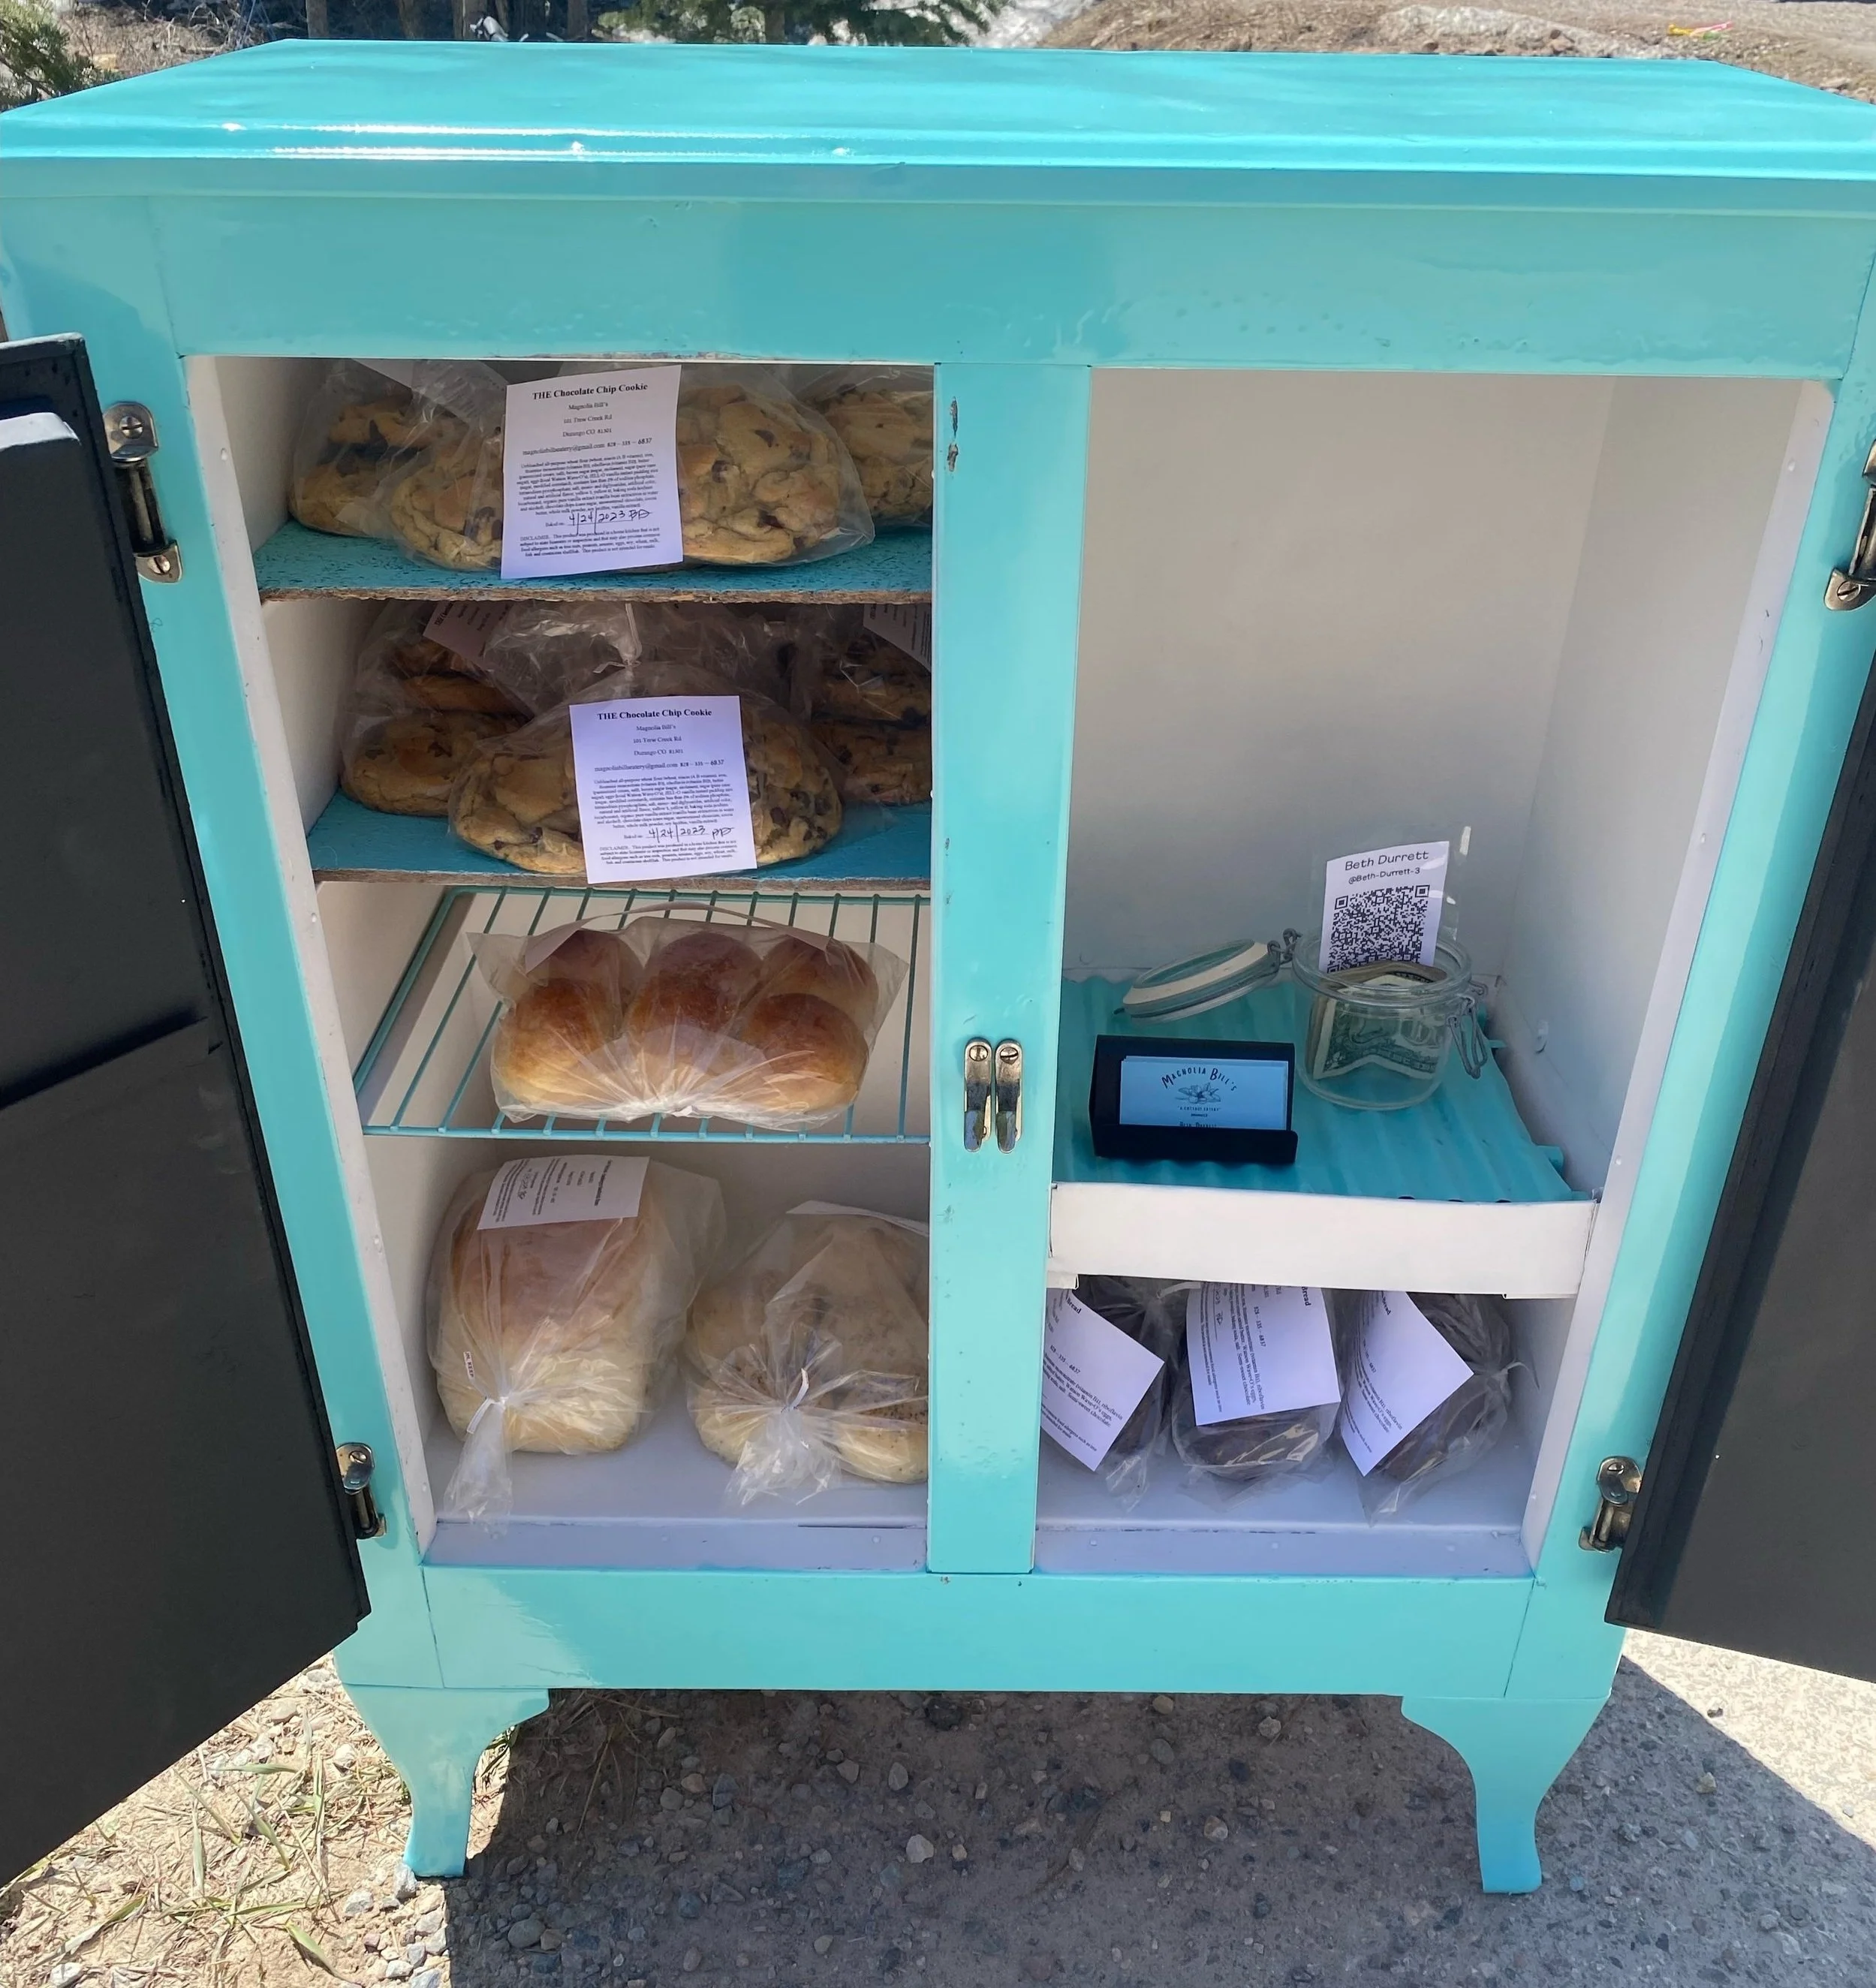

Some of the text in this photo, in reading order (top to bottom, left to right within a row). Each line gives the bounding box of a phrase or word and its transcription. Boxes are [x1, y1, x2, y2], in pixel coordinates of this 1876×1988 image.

[533, 381, 647, 399] THE Chocolate Chip Cookie
[619, 709, 660, 719] Chocolate
[661, 709, 682, 718] Chip
[683, 708, 712, 717] Cookie
[649, 824, 706, 843] 4/24/2023
[1345, 851, 1429, 871] Beth Durrett
[1348, 867, 1420, 884] @Beth-Durrett-3
[1161, 1067, 1237, 1091] MAGNOLIA BILL'S
[1301, 1285, 1311, 1306] Bread
[1065, 1297, 1083, 1314] Bread
[1068, 1363, 1081, 1375] 6837
